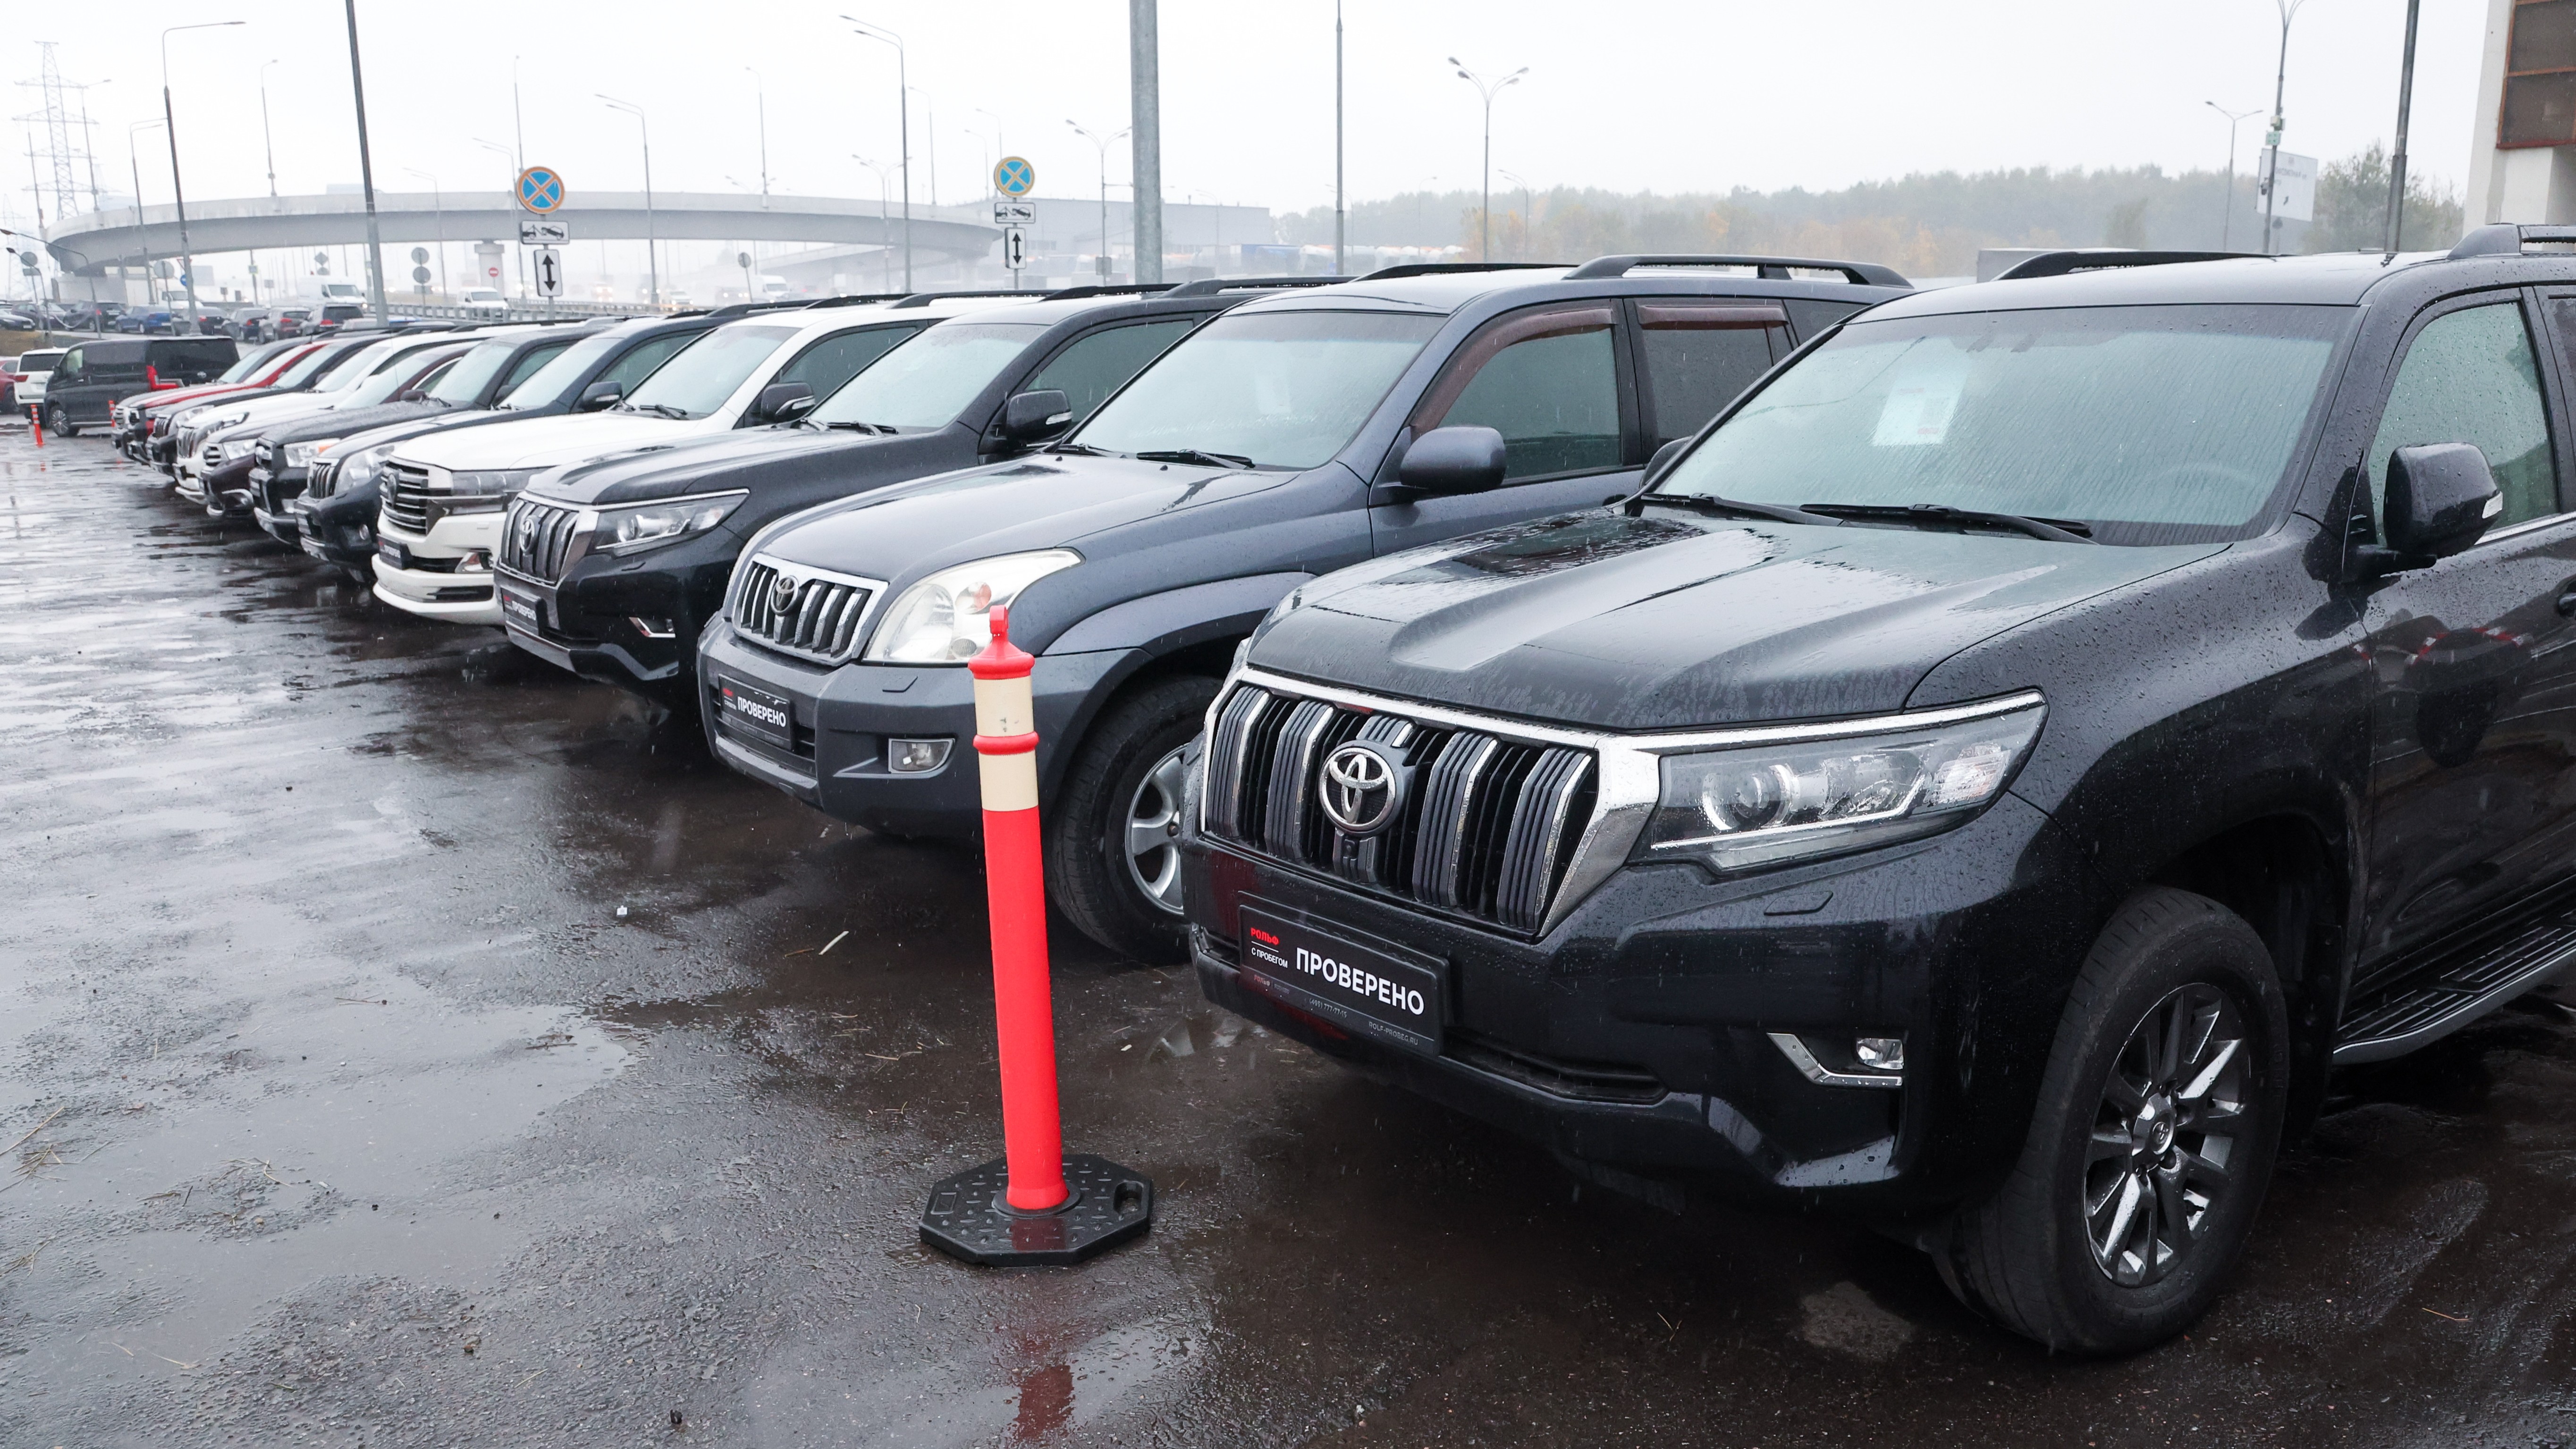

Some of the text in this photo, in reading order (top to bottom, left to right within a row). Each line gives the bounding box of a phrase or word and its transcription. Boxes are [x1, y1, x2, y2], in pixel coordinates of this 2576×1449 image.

[737, 696, 786, 727] ПРОВЕРЕНО
[1250, 927, 1279, 945] РОЛЬФ
[1251, 947, 1288, 968] С ПРОБЕГОМ
[1297, 947, 1424, 1015] ПРОВЕРЕНО
[1309, 998, 1323, 1009] (495)
